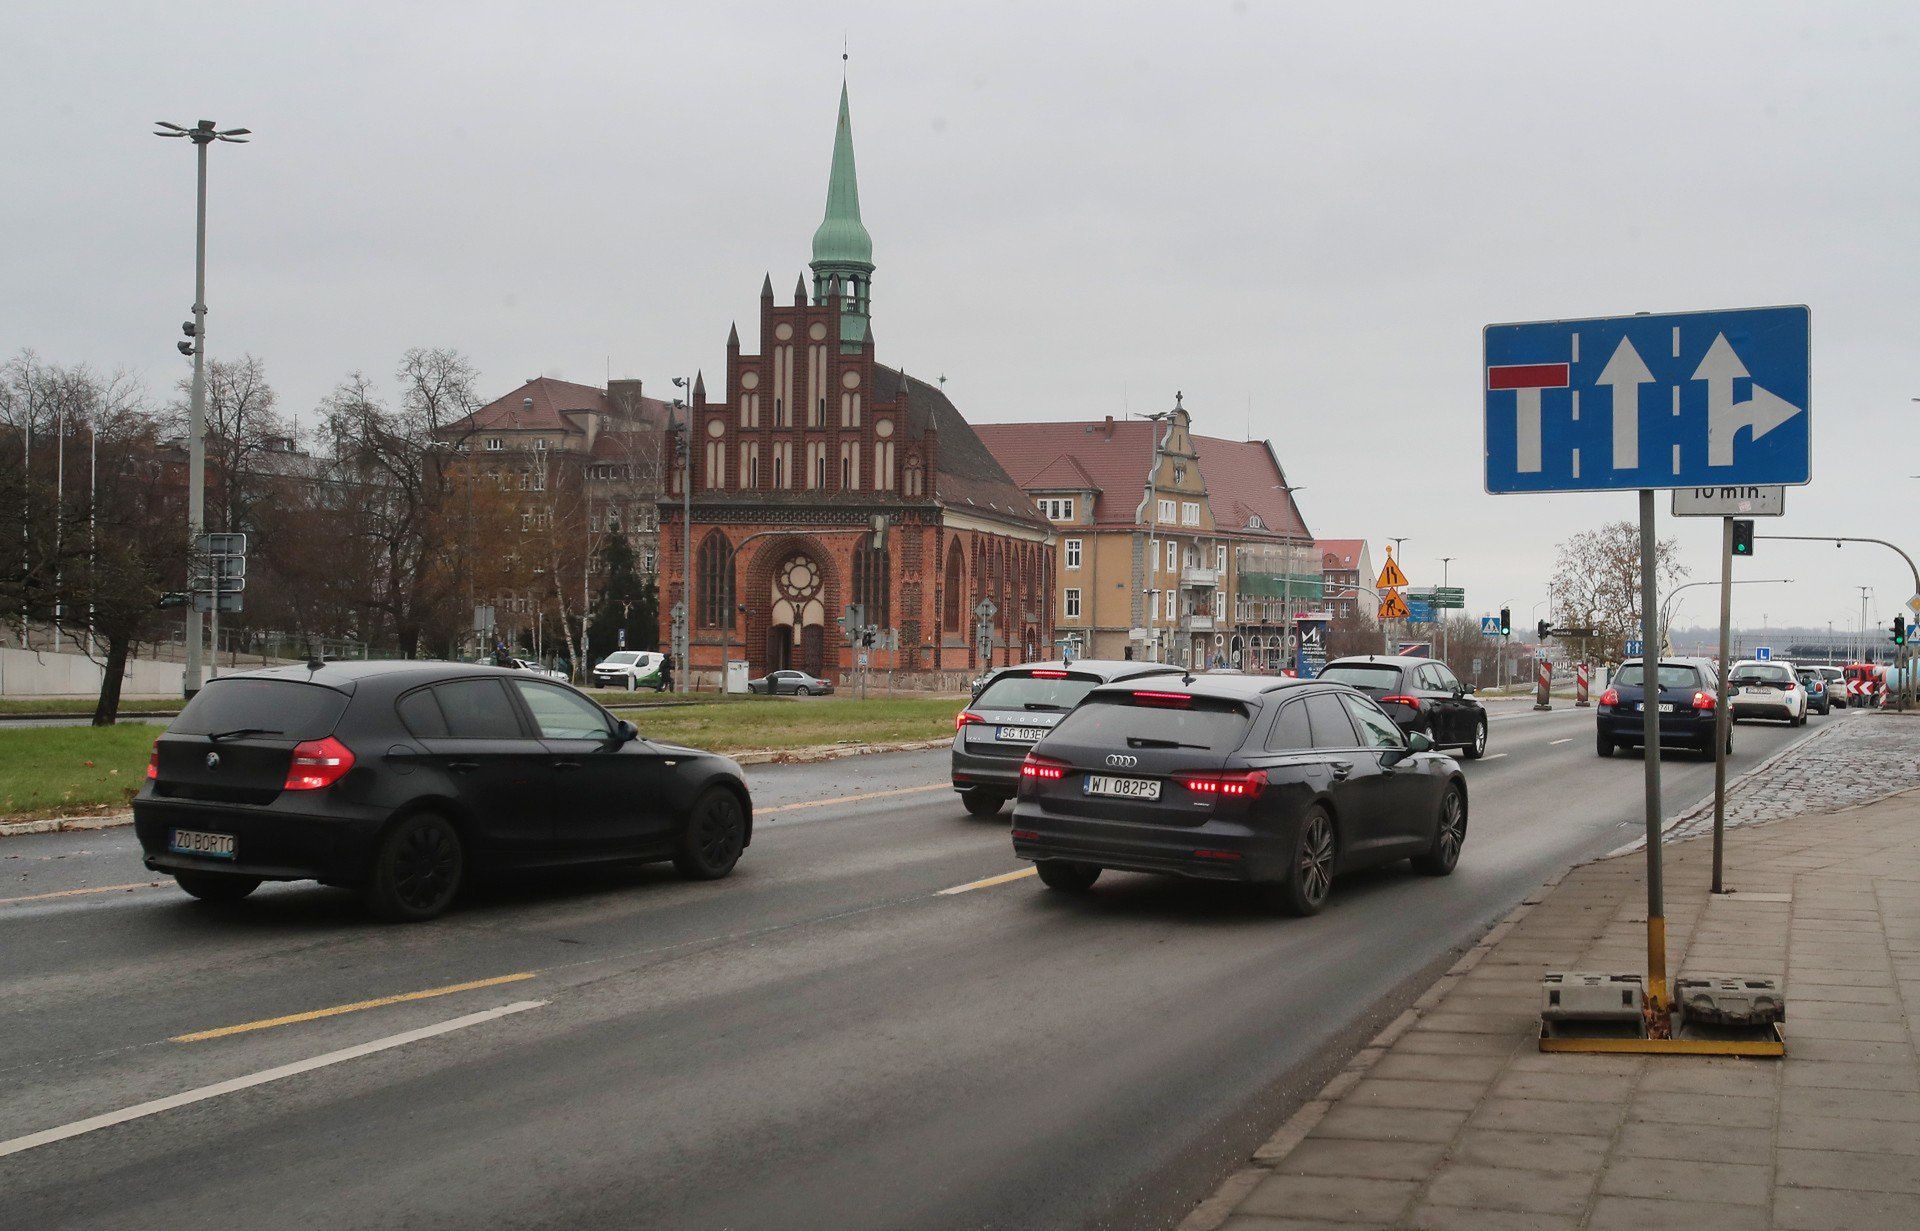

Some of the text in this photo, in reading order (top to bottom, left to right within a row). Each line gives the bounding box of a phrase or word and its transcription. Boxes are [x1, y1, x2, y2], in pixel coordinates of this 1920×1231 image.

[1003, 727, 1015, 738] SG
[1092, 777, 1157, 796] WI 082PS
